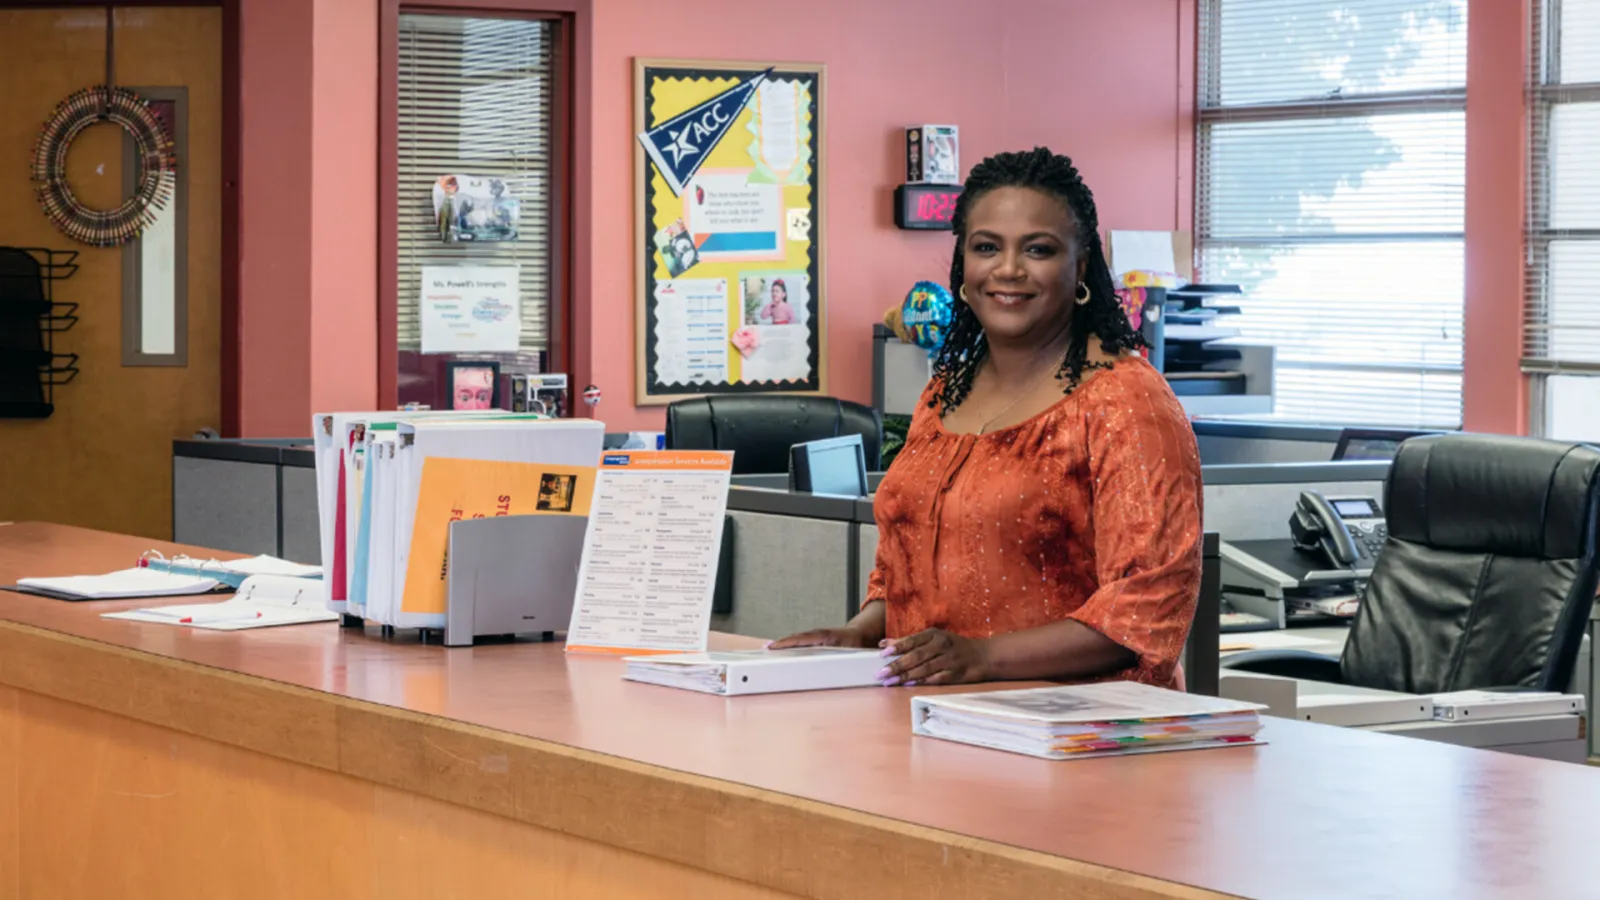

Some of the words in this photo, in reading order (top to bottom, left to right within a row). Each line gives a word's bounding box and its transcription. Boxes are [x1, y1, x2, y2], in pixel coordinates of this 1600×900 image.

[693, 103, 729, 143] ACC
[447, 280, 475, 288] Powell's
[476, 281, 507, 289] Strengths
